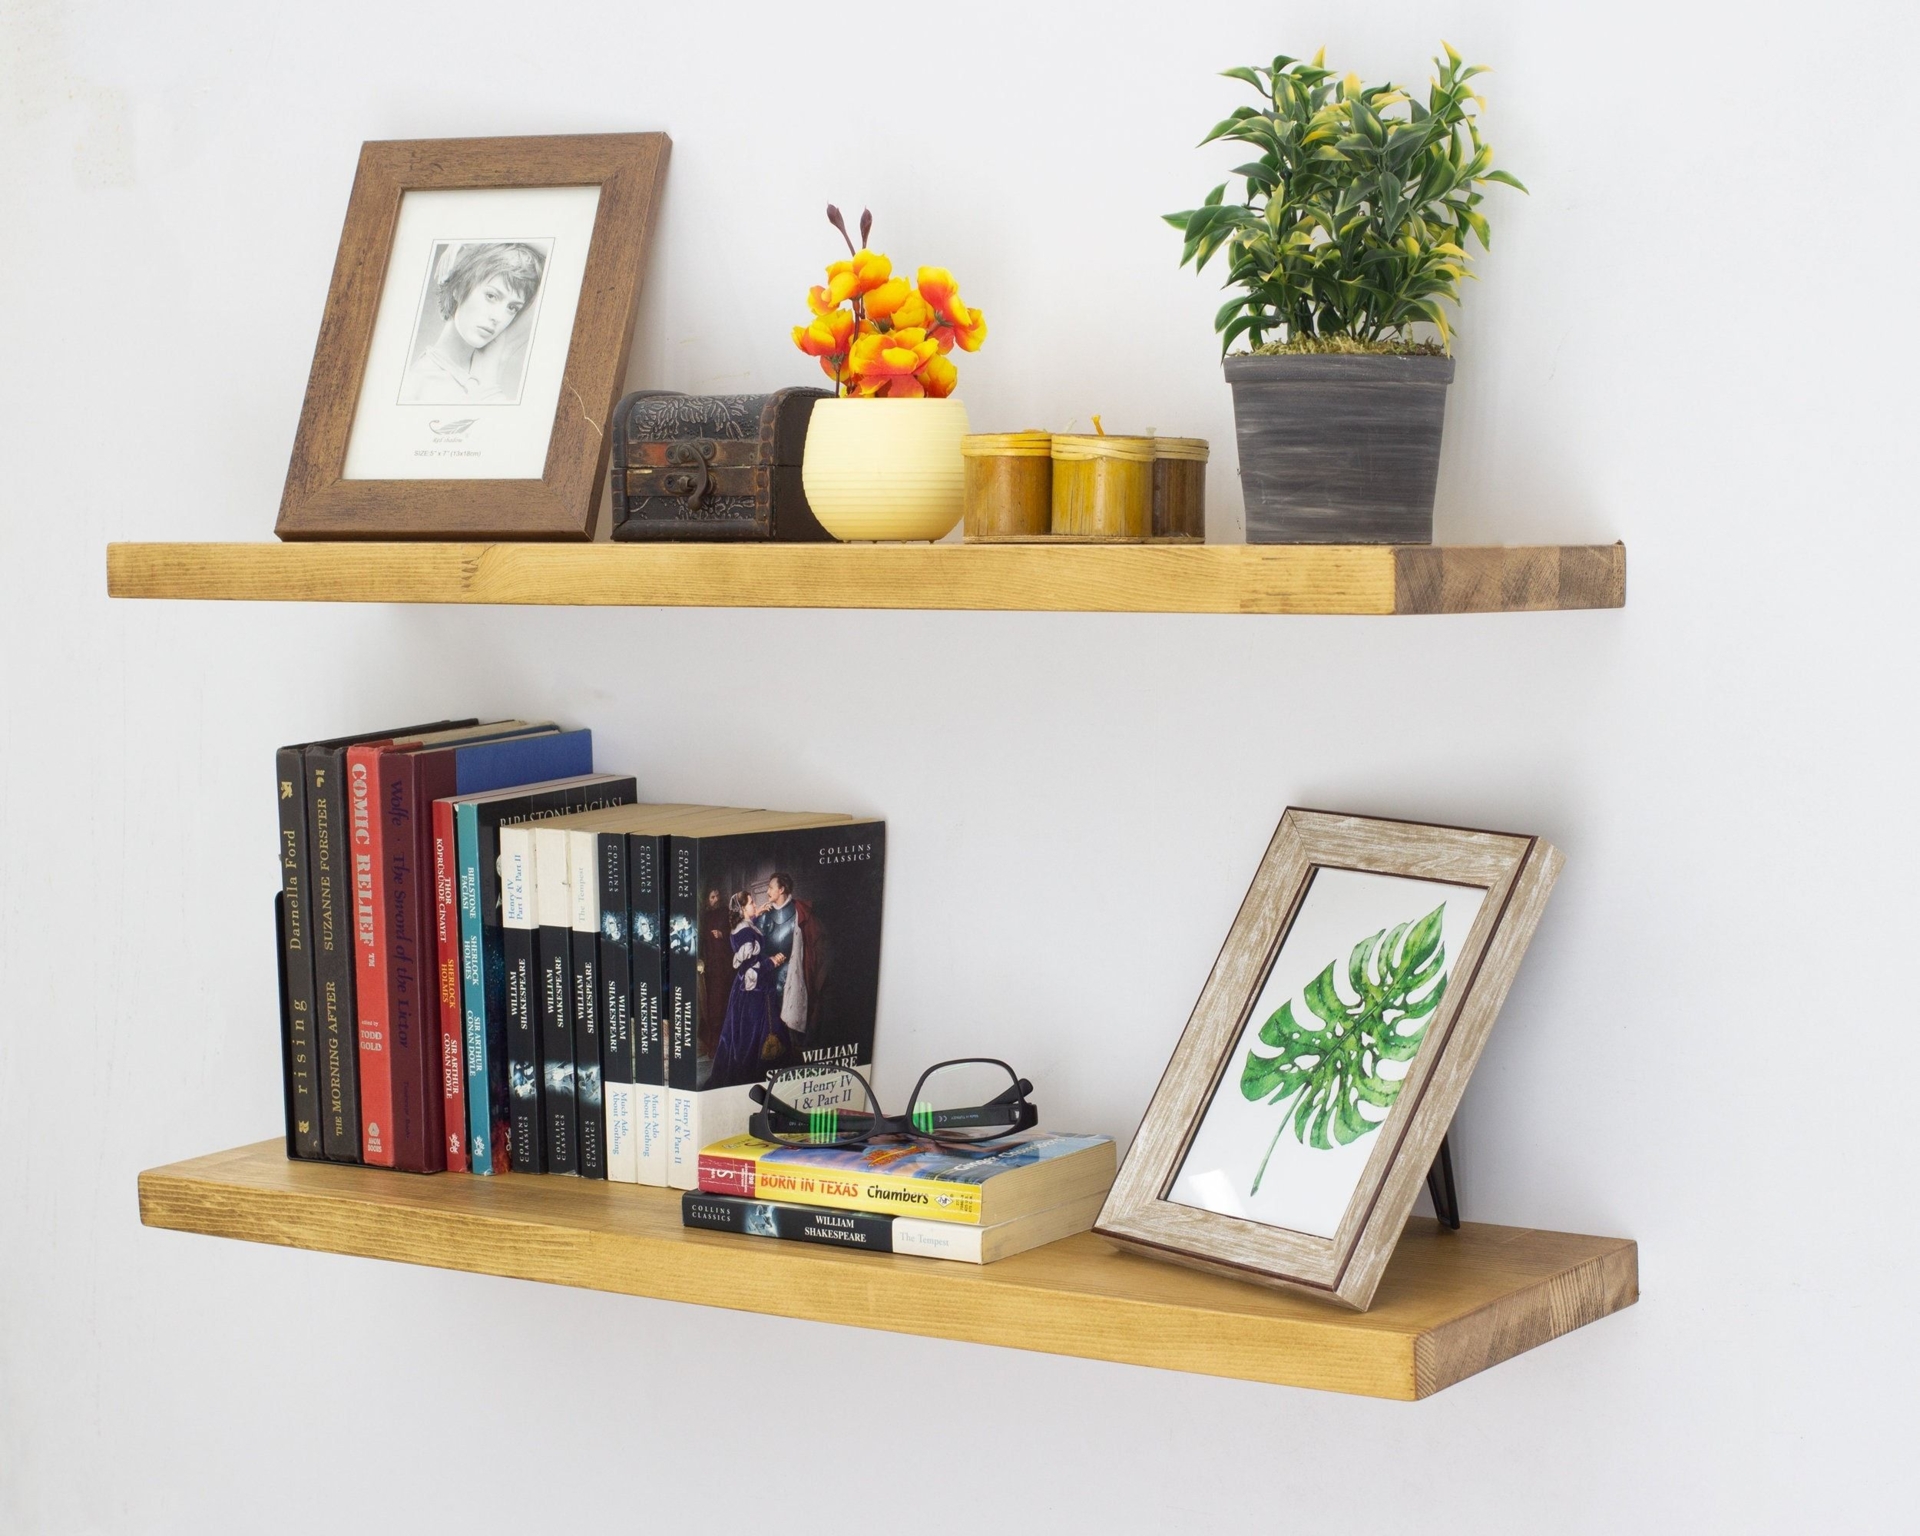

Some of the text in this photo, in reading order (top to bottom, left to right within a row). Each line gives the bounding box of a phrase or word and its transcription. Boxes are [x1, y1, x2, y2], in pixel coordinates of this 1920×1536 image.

[352, 763, 370, 845] COMIC
[388, 780, 409, 826] Wolfe
[819, 843, 871, 856] COLLINS
[819, 853, 871, 865] CLASSICS
[283, 830, 301, 950] Darnella Ford
[317, 798, 334, 951] SUZANNE FORSTER
[444, 877, 452, 905] THOR
[467, 867, 476, 919] BIRLSTONE
[578, 867, 586, 922] The Tempest
[356, 854, 374, 947] RELIEF
[507, 879, 517, 919] Henry IV
[392, 852, 414, 1048] The Sword of the Lictor
[464, 940, 472, 980] HOLMES
[470, 935, 479, 986] SHERLOCK
[441, 963, 449, 1003] HOLMES
[447, 958, 456, 1009] SHERLOCK
[510, 971, 518, 1016] WILLIAM
[519, 958, 528, 1030] SHAKESPEARE
[546, 969, 554, 1014] WILLIAM
[554, 956, 564, 1028] SHAKESPEARE
[576, 975, 584, 1019] WILLIAM
[585, 962, 594, 1034] SHAKESPEARE
[360, 1030, 383, 1040] TODD
[608, 980, 618, 1053] SHAKESPEARE
[618, 995, 627, 1040] WILLIAM
[640, 981, 649, 1054] SHAKESPEARE
[650, 996, 658, 1042] WILLIAM
[674, 986, 682, 1059] SHAKESPEARE
[684, 1001, 692, 1047] WILLIAM
[293, 999, 308, 1094] rising
[326, 981, 343, 1136] THE MORNING AFTER
[360, 1041, 383, 1052] GOLD
[467, 1010, 476, 1077] CONAN DOYLE
[475, 1034, 483, 1071] ARTHUR
[802, 1042, 859, 1063] WILLIAM
[443, 1033, 453, 1099] CONAN DOYLE
[451, 1057, 459, 1094] ARTHUR
[802, 1074, 854, 1095] Henry IV
[674, 1098, 682, 1115] Part
[682, 1099, 691, 1141] Henry IV
[802, 1097, 813, 1110] &
[817, 1094, 839, 1108] Part
[842, 1089, 852, 1102] II
[612, 1091, 621, 1155] About Nothing
[621, 1119, 629, 1136] Ado
[643, 1093, 652, 1157] About Nothing
[652, 1121, 660, 1138] Ado
[674, 1136, 682, 1154] Part
[675, 1125, 682, 1133] &
[675, 1156, 682, 1164] II
[760, 1173, 796, 1189] BORN
[801, 1178, 815, 1192] IN
[819, 1179, 859, 1198] TEXAS
[867, 1185, 929, 1205] Chambers
[691, 1204, 731, 1215] COLLINS
[692, 1211, 731, 1222] CLASSICS
[815, 1215, 855, 1228] WILLIAM
[804, 1227, 867, 1242] SHAKESPEARE
[900, 1231, 950, 1248] The Tempest
